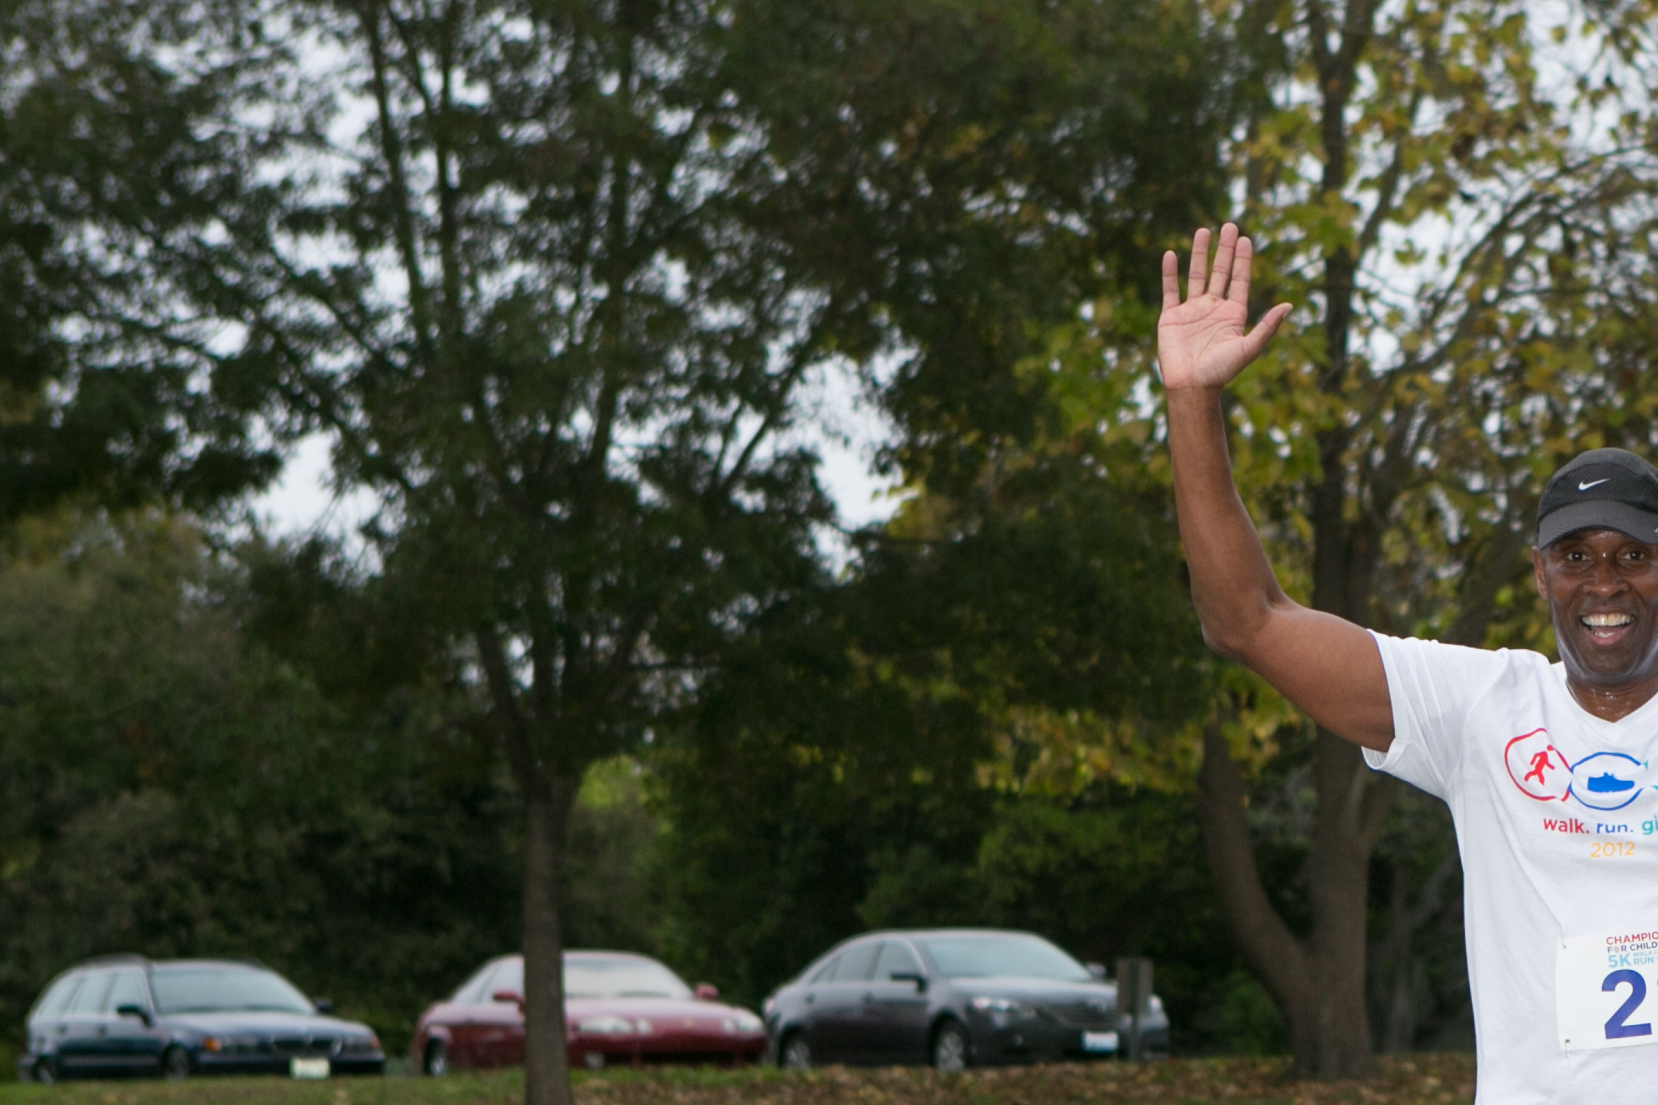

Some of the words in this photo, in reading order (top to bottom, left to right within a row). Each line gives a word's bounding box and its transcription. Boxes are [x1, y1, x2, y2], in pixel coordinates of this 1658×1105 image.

[1543, 818, 1589, 834] walk.
[1596, 823, 1634, 833] run.
[1590, 841, 1635, 857] 2012
[1608, 953, 1632, 968] 5K
[1633, 957, 1654, 965] RUN
